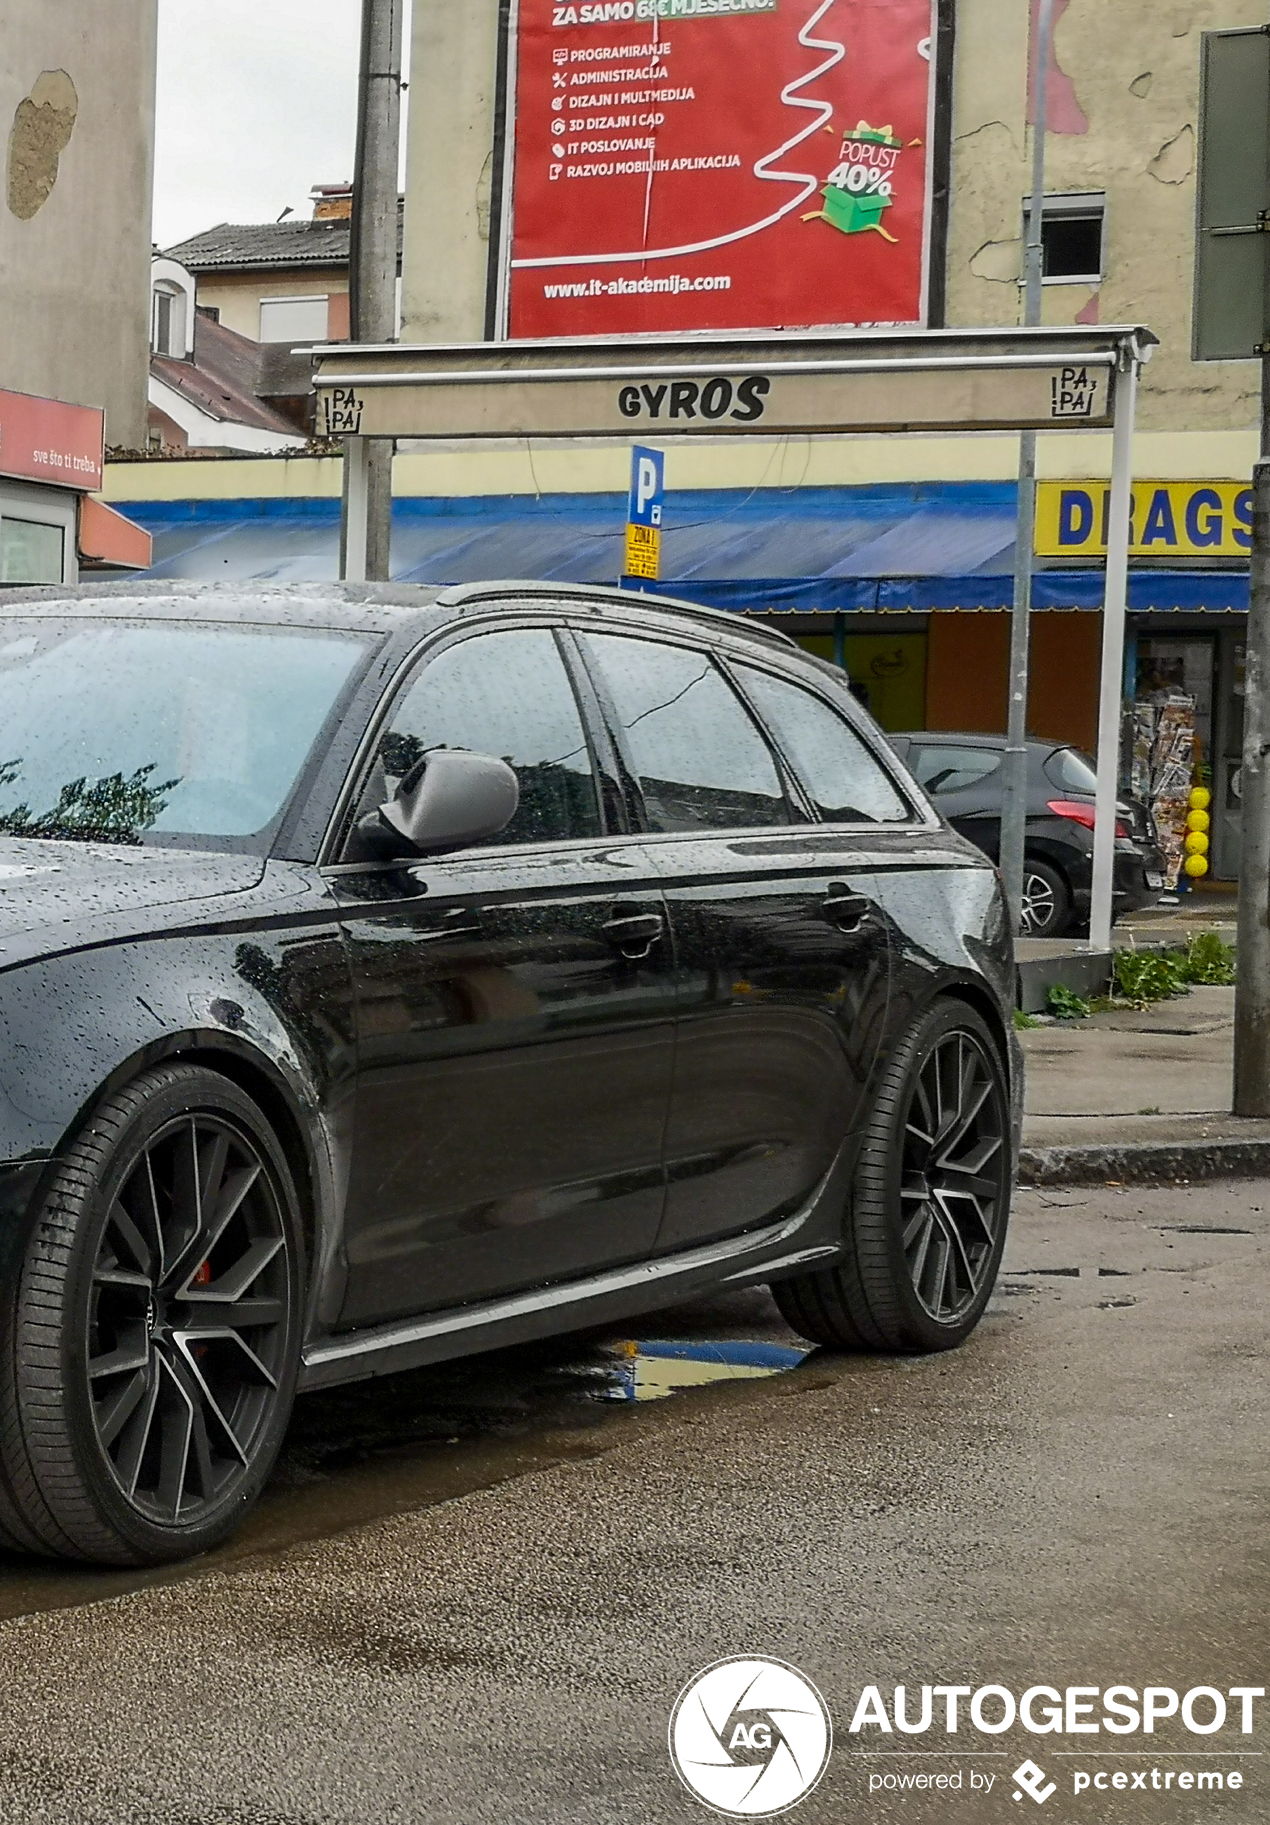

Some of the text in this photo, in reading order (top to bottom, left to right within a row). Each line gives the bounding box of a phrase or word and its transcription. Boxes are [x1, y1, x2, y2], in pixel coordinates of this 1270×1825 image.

[552, 7, 577, 26] ZA
[579, 2, 633, 23] SAMO
[570, 42, 671, 62] PROGRAMIRANJE
[570, 66, 668, 86] ADMINISTRACIJA
[569, 94, 612, 109] DIZAJN
[614, 93, 619, 105] I
[569, 112, 665, 132] 3D DIZAJN I CAD
[567, 137, 656, 155] IT POSLOVANJE
[839, 141, 901, 168] POPUST
[567, 154, 741, 178] RAZVOJ MOBILNIH APLIKACIJA
[827, 162, 893, 197] 40%
[544, 274, 731, 298] www.it-akademija.com
[618, 376, 770, 421] GYROS
[33, 449, 95, 473] sve što ti treba
[637, 457, 656, 514] P
